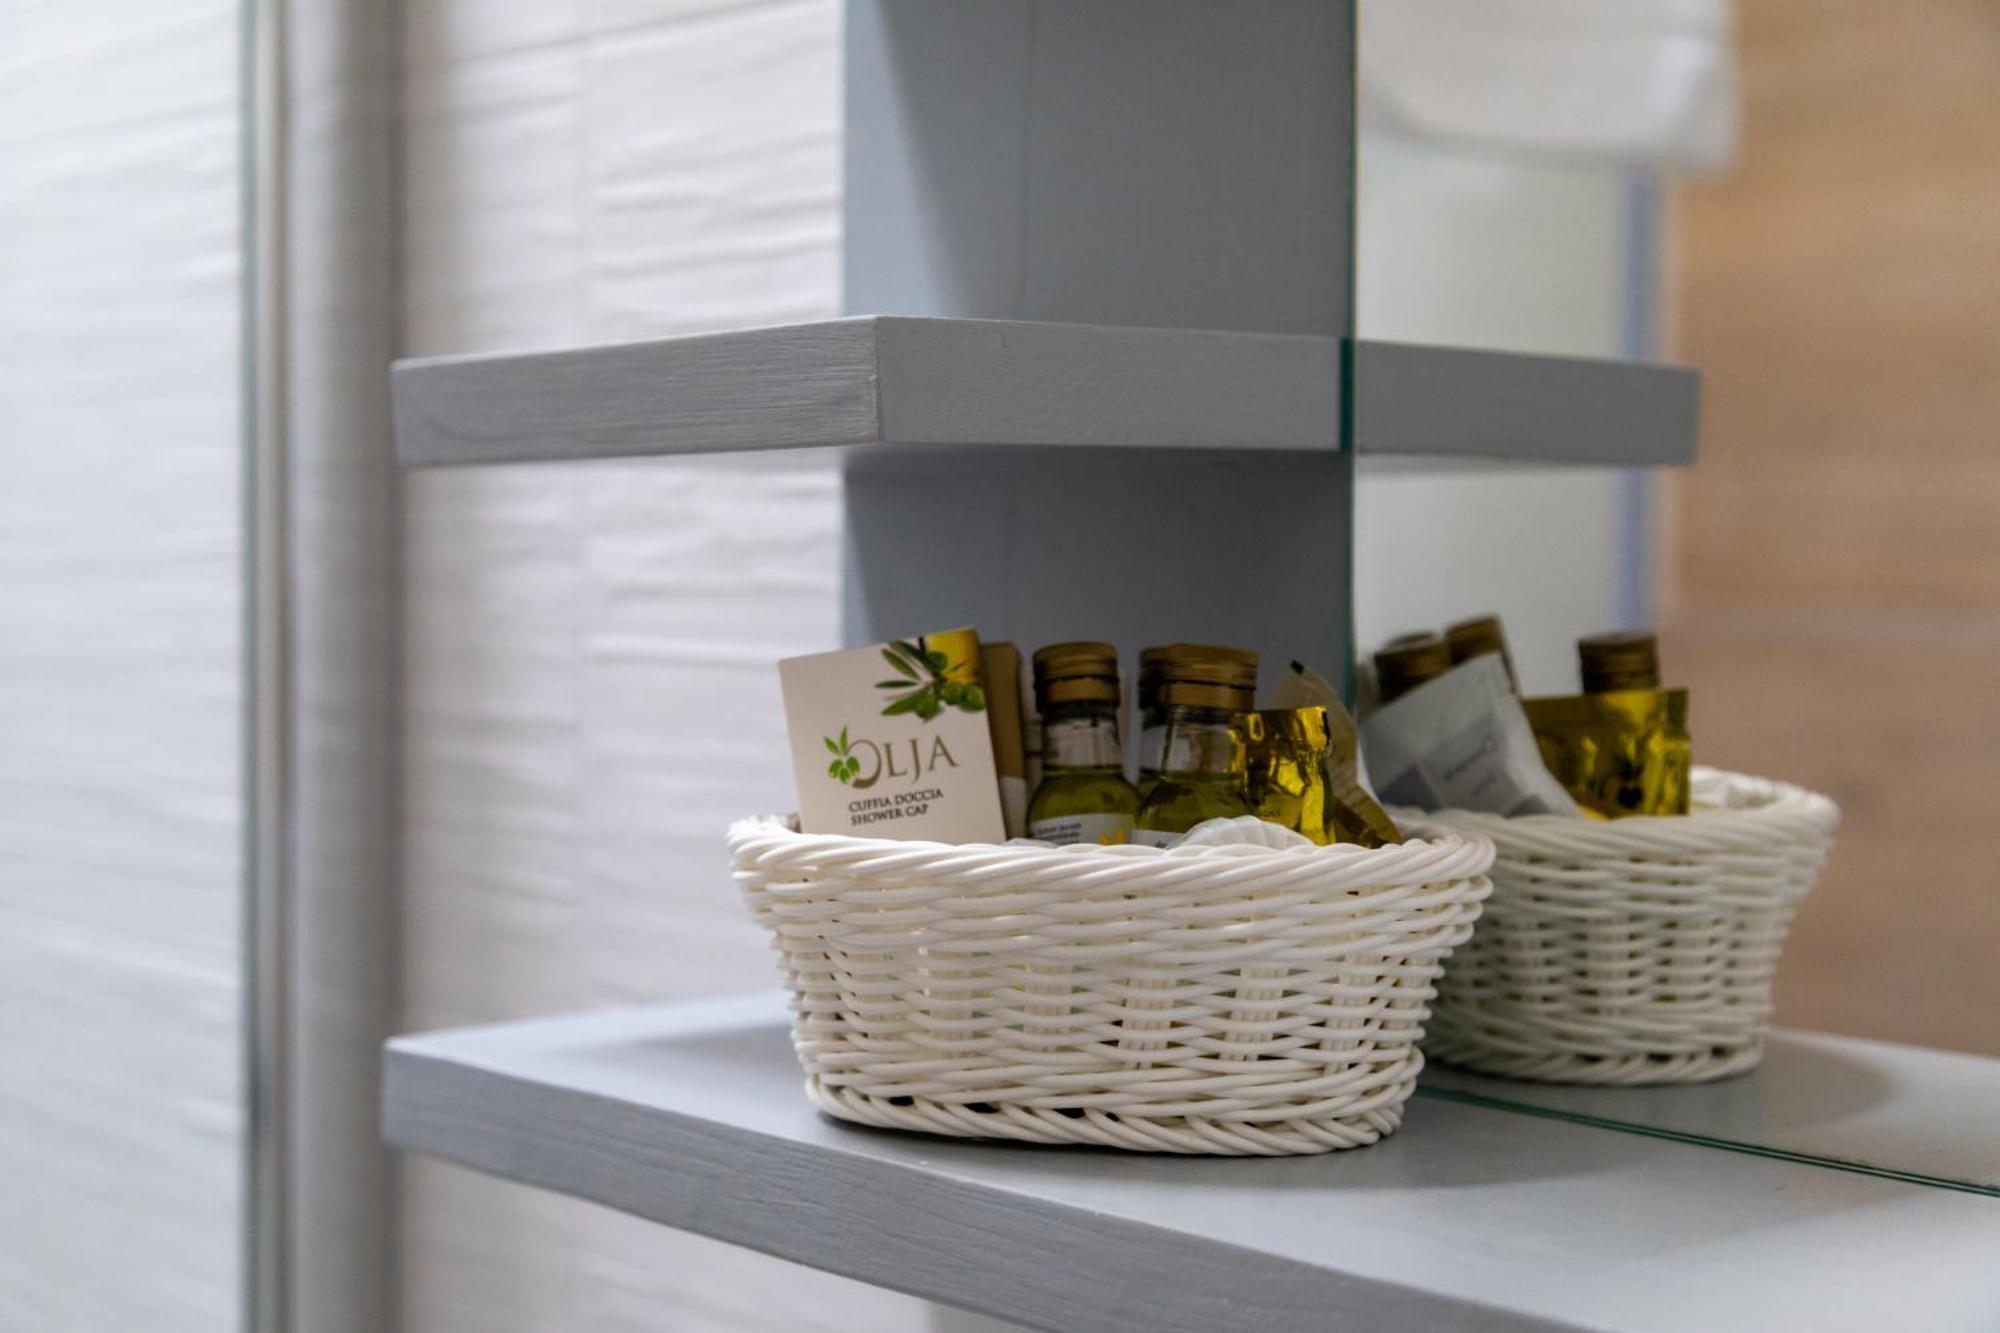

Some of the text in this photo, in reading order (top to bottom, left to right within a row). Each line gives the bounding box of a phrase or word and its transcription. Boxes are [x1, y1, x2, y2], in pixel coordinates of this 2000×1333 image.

[848, 735, 959, 789] OLJA
[849, 789, 944, 812] CUFFIA DOCCIA
[850, 803, 929, 826] SHOWER CAP
